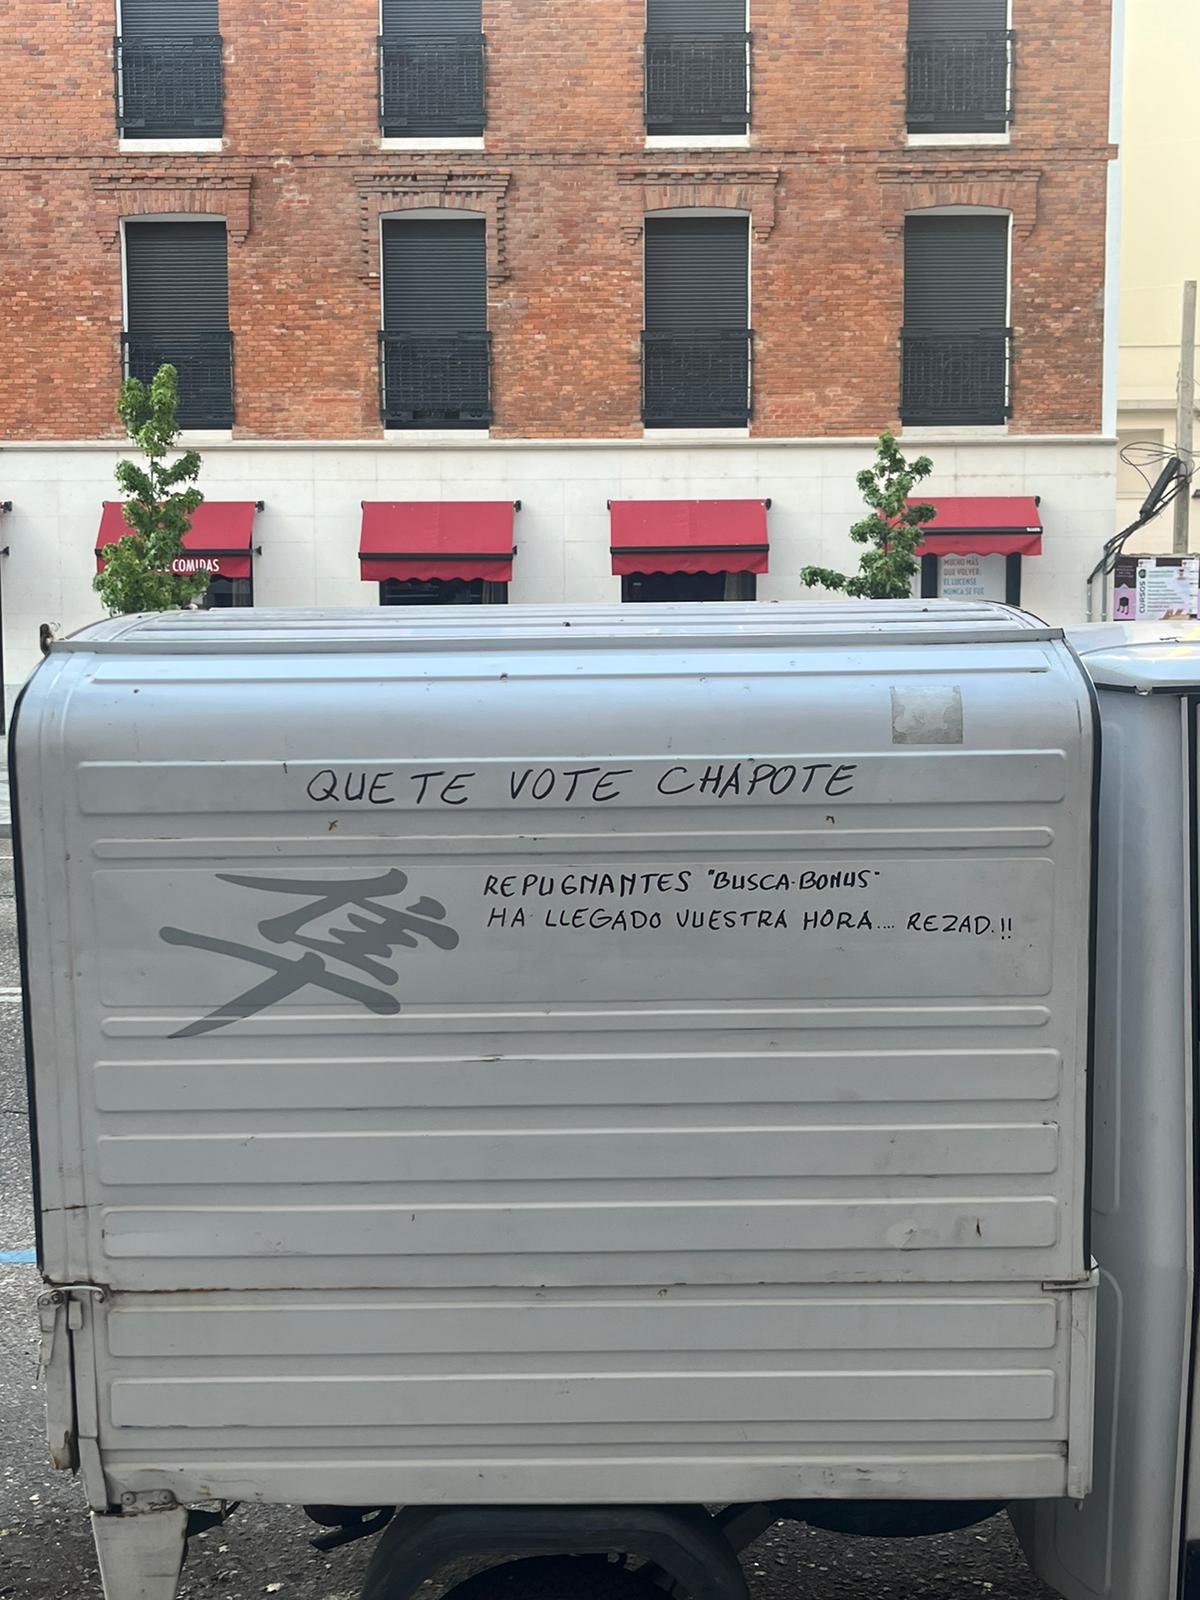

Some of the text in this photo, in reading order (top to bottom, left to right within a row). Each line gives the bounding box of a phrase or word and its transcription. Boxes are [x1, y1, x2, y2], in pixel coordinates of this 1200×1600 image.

[172, 558, 220, 572] COMIDAS
[1138, 580, 1147, 614] CURSOS
[306, 763, 858, 805] QUE TE VOTE CHAPOTE
[483, 870, 692, 898] REPUGNANTES
[544, 907, 662, 932] LLEGADO
[676, 908, 788, 931] VUESTRA
